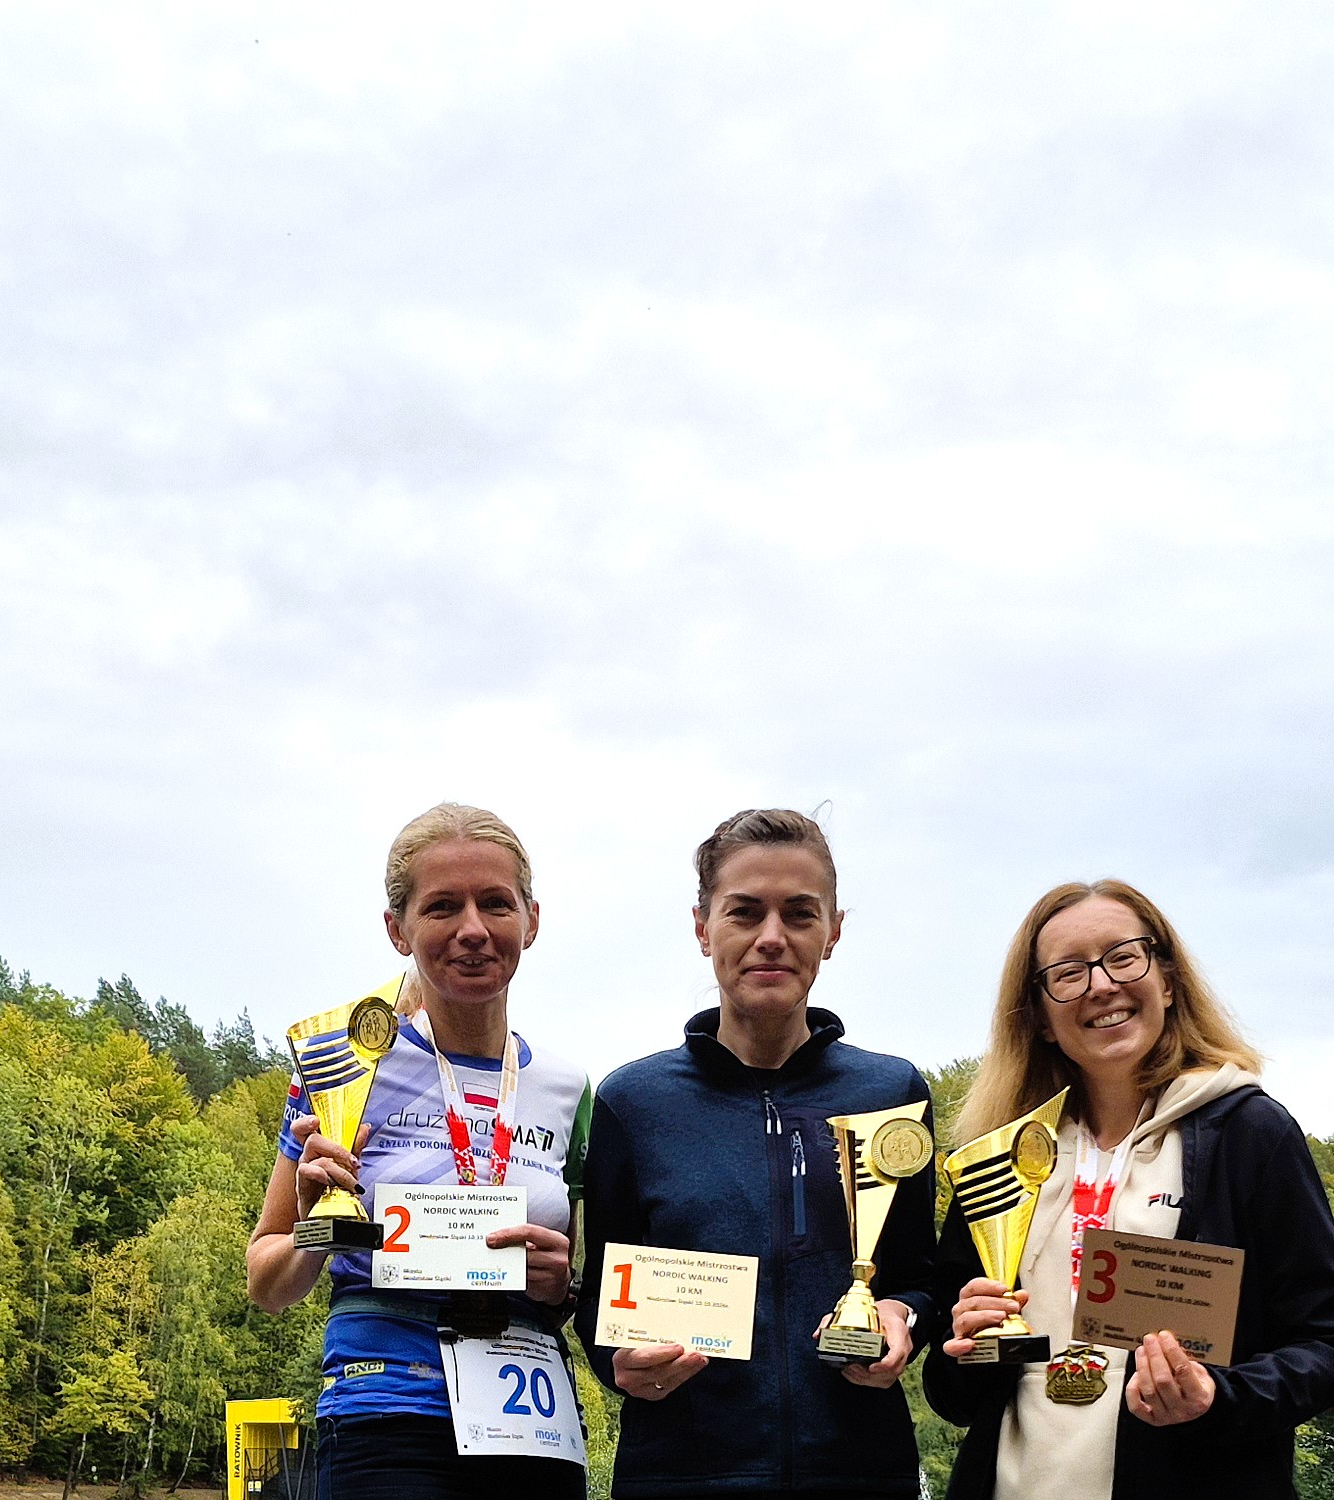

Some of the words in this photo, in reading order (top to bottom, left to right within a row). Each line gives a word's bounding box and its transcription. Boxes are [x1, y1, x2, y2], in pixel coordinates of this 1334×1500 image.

[404, 1192, 465, 1201] Ogólnopolskie
[467, 1193, 518, 1201] Mistrzostwa
[423, 1207, 457, 1215] NORDIC
[458, 1208, 499, 1216] WALKING
[382, 1205, 411, 1253] 2
[460, 1222, 475, 1230] KM
[635, 1254, 695, 1267] Ogólnopolskie
[696, 1260, 748, 1272] Mistrzostwa
[1131, 1259, 1167, 1272] NORDIC
[1169, 1264, 1212, 1279] WALKING
[467, 1270, 508, 1280] mosir
[652, 1270, 686, 1280] NORDIC
[688, 1274, 729, 1284] WALKING
[1086, 1249, 1117, 1304] 3
[610, 1263, 637, 1310] 1
[688, 1287, 703, 1295] KM
[1155, 1279, 1166, 1288] 10
[1168, 1281, 1185, 1291] KM
[691, 1336, 732, 1348] mosir
[498, 1363, 556, 1419] 20
[535, 1429, 562, 1441] mosir
